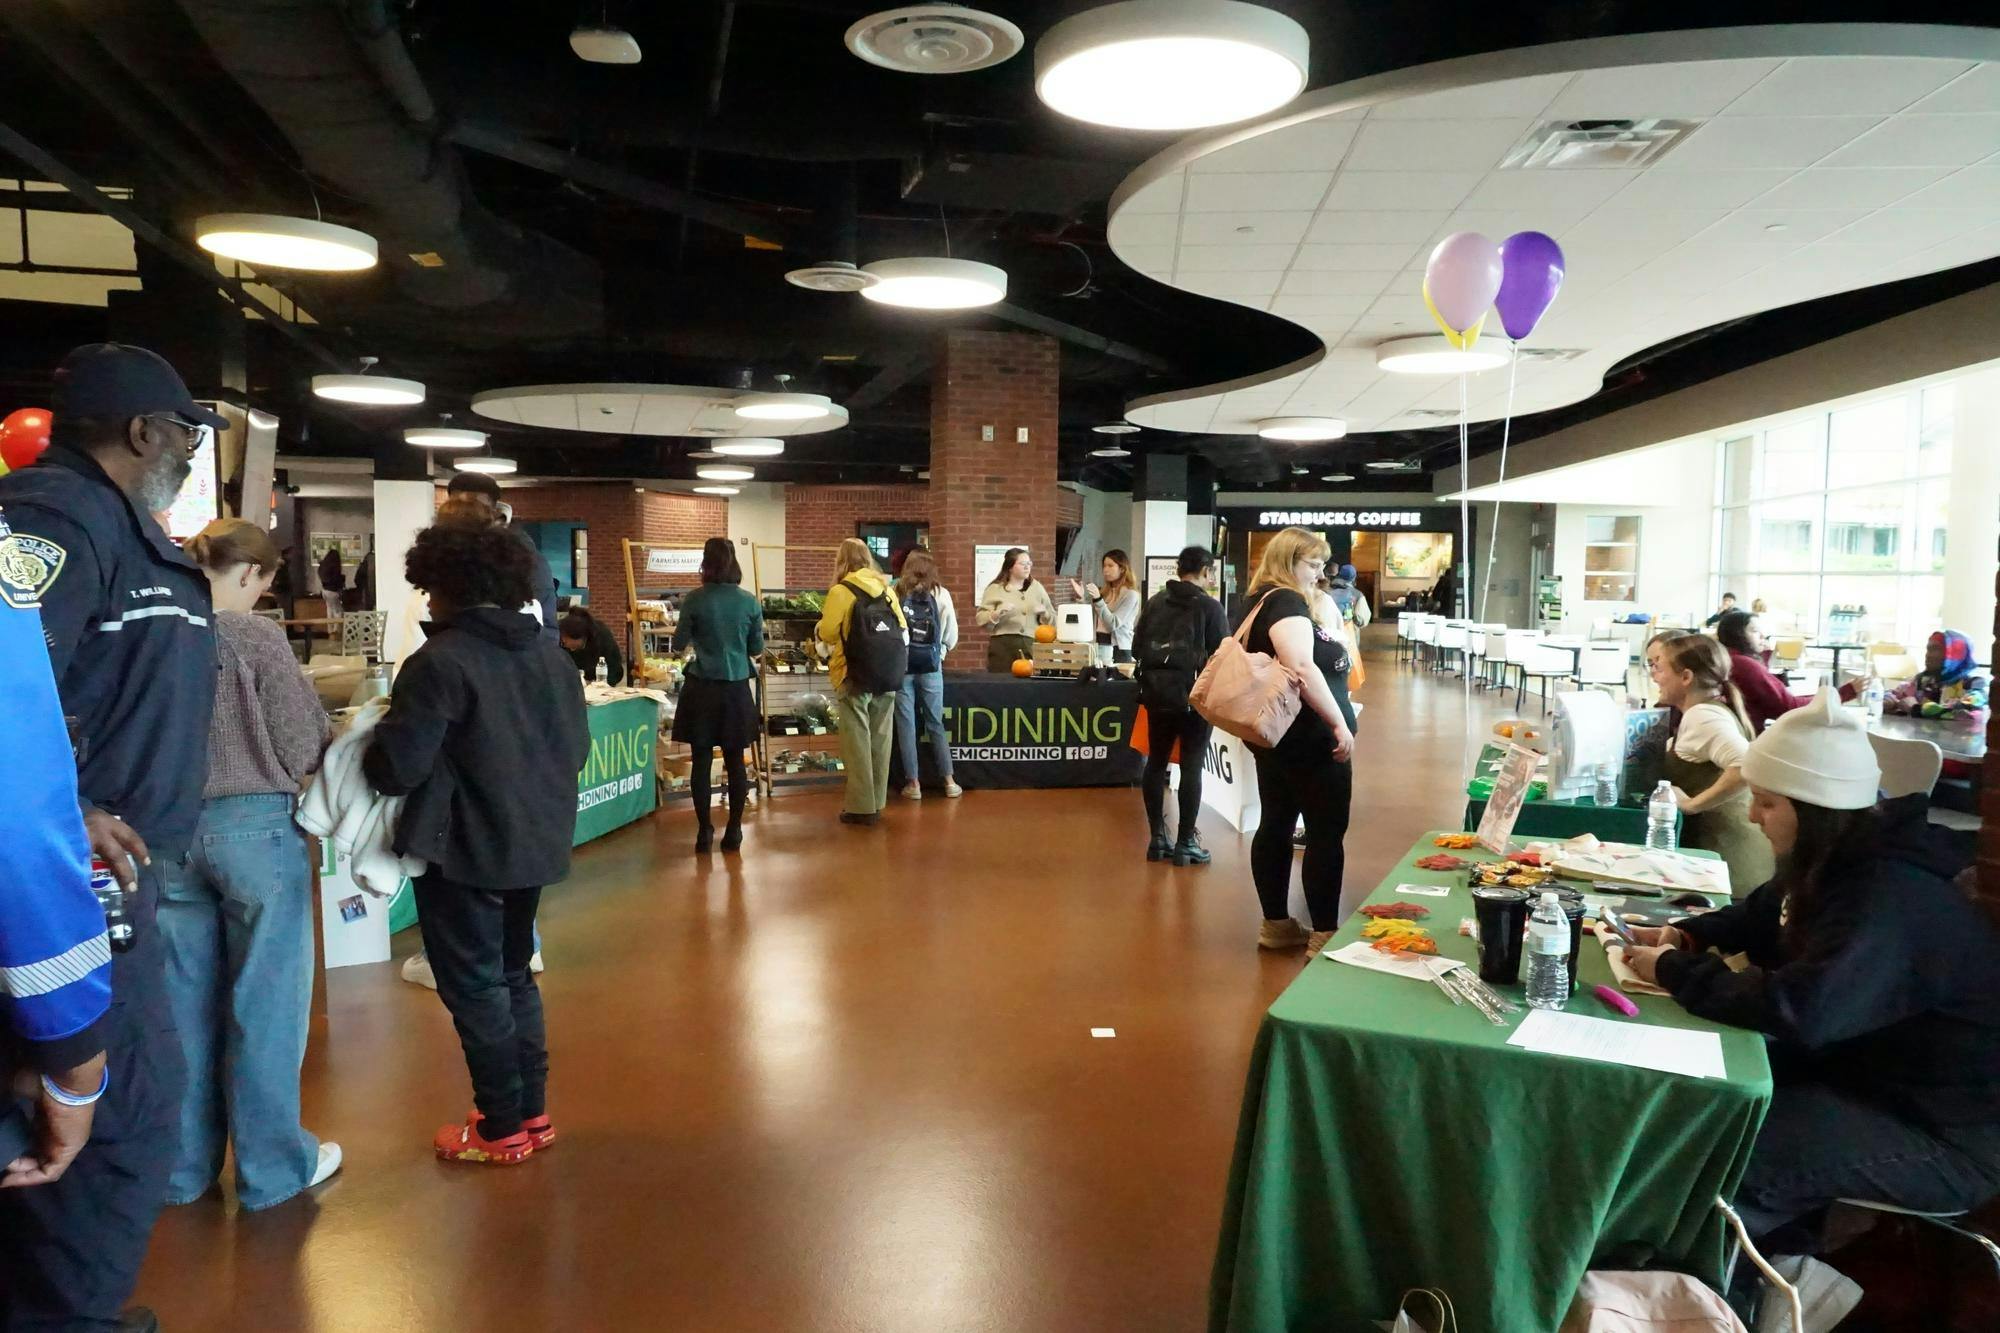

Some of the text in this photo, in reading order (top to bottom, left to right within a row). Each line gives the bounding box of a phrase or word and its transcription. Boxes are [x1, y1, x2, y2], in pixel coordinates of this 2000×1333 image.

[1259, 512, 1421, 525] STARBUCKS COFFEE
[15, 538, 61, 559] POLICE
[130, 590, 139, 598] T.
[967, 706, 1121, 744] DINING
[578, 724, 649, 787] INING
[1203, 742, 1233, 784] ING
